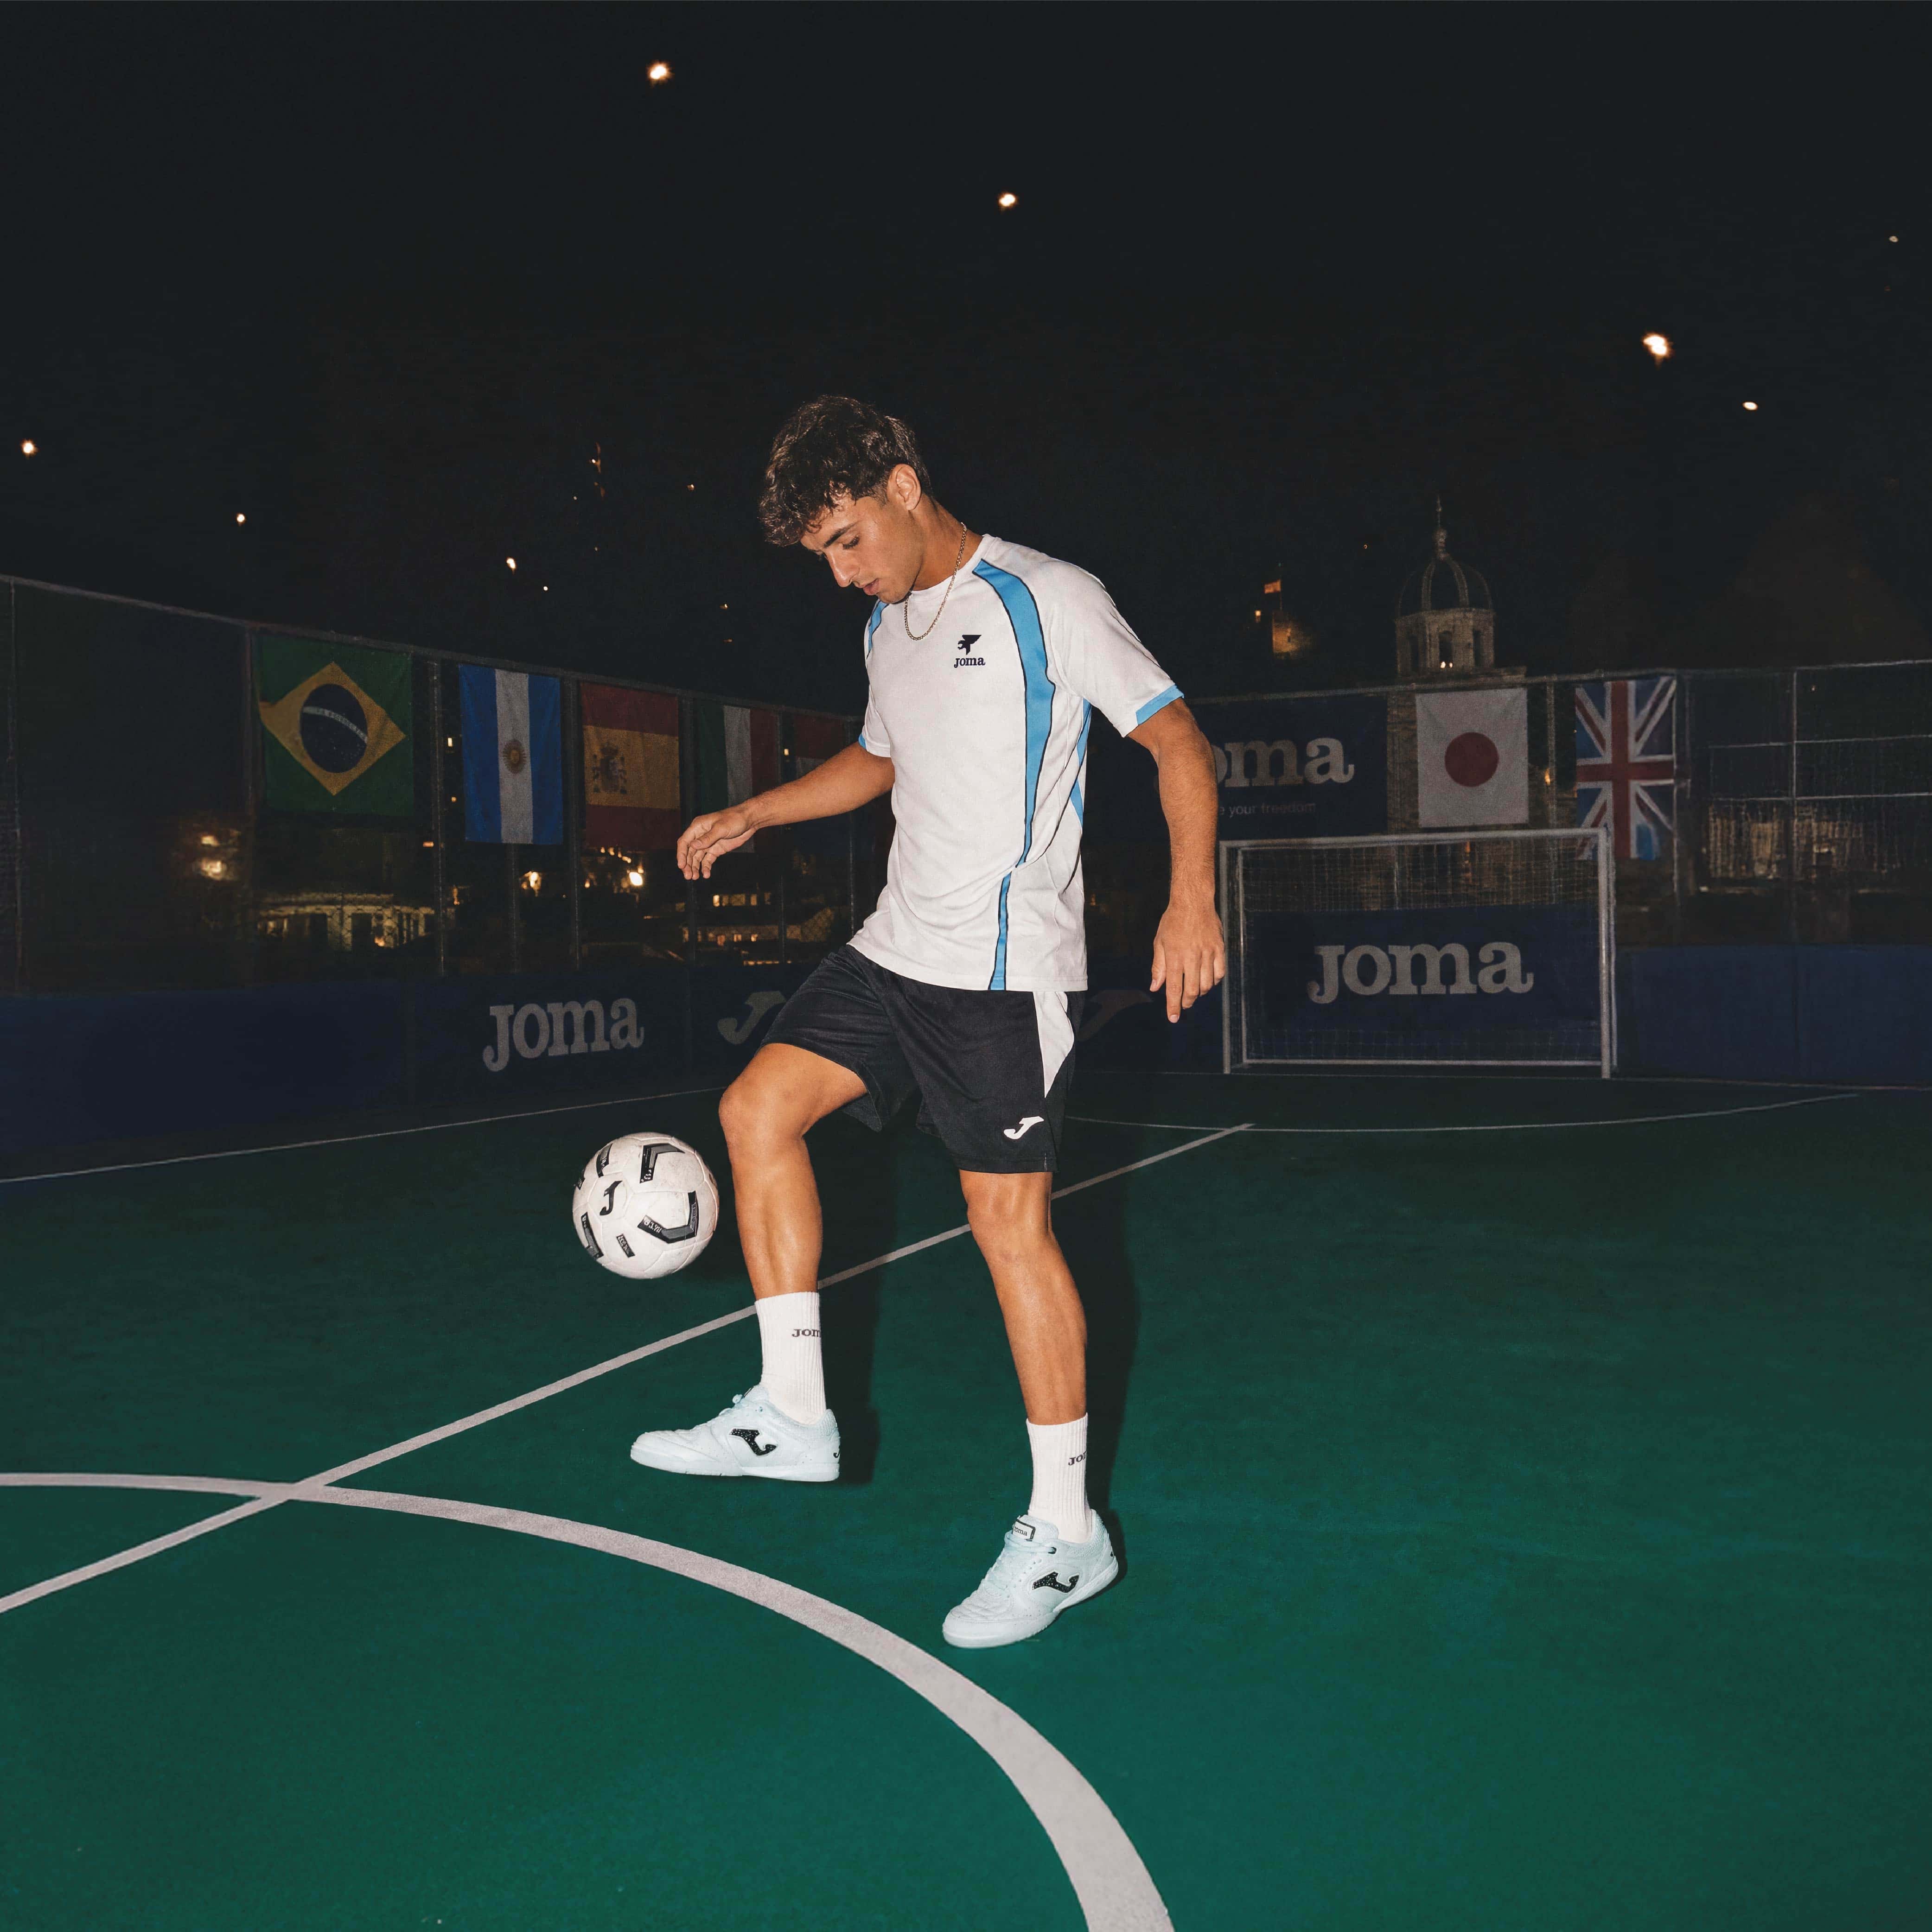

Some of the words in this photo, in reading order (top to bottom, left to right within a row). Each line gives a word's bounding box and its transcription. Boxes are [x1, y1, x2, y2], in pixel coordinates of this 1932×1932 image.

[1214, 737, 1354, 788] ma
[1229, 805, 1257, 819] your
[1014, 1526, 1027, 1536] oma
